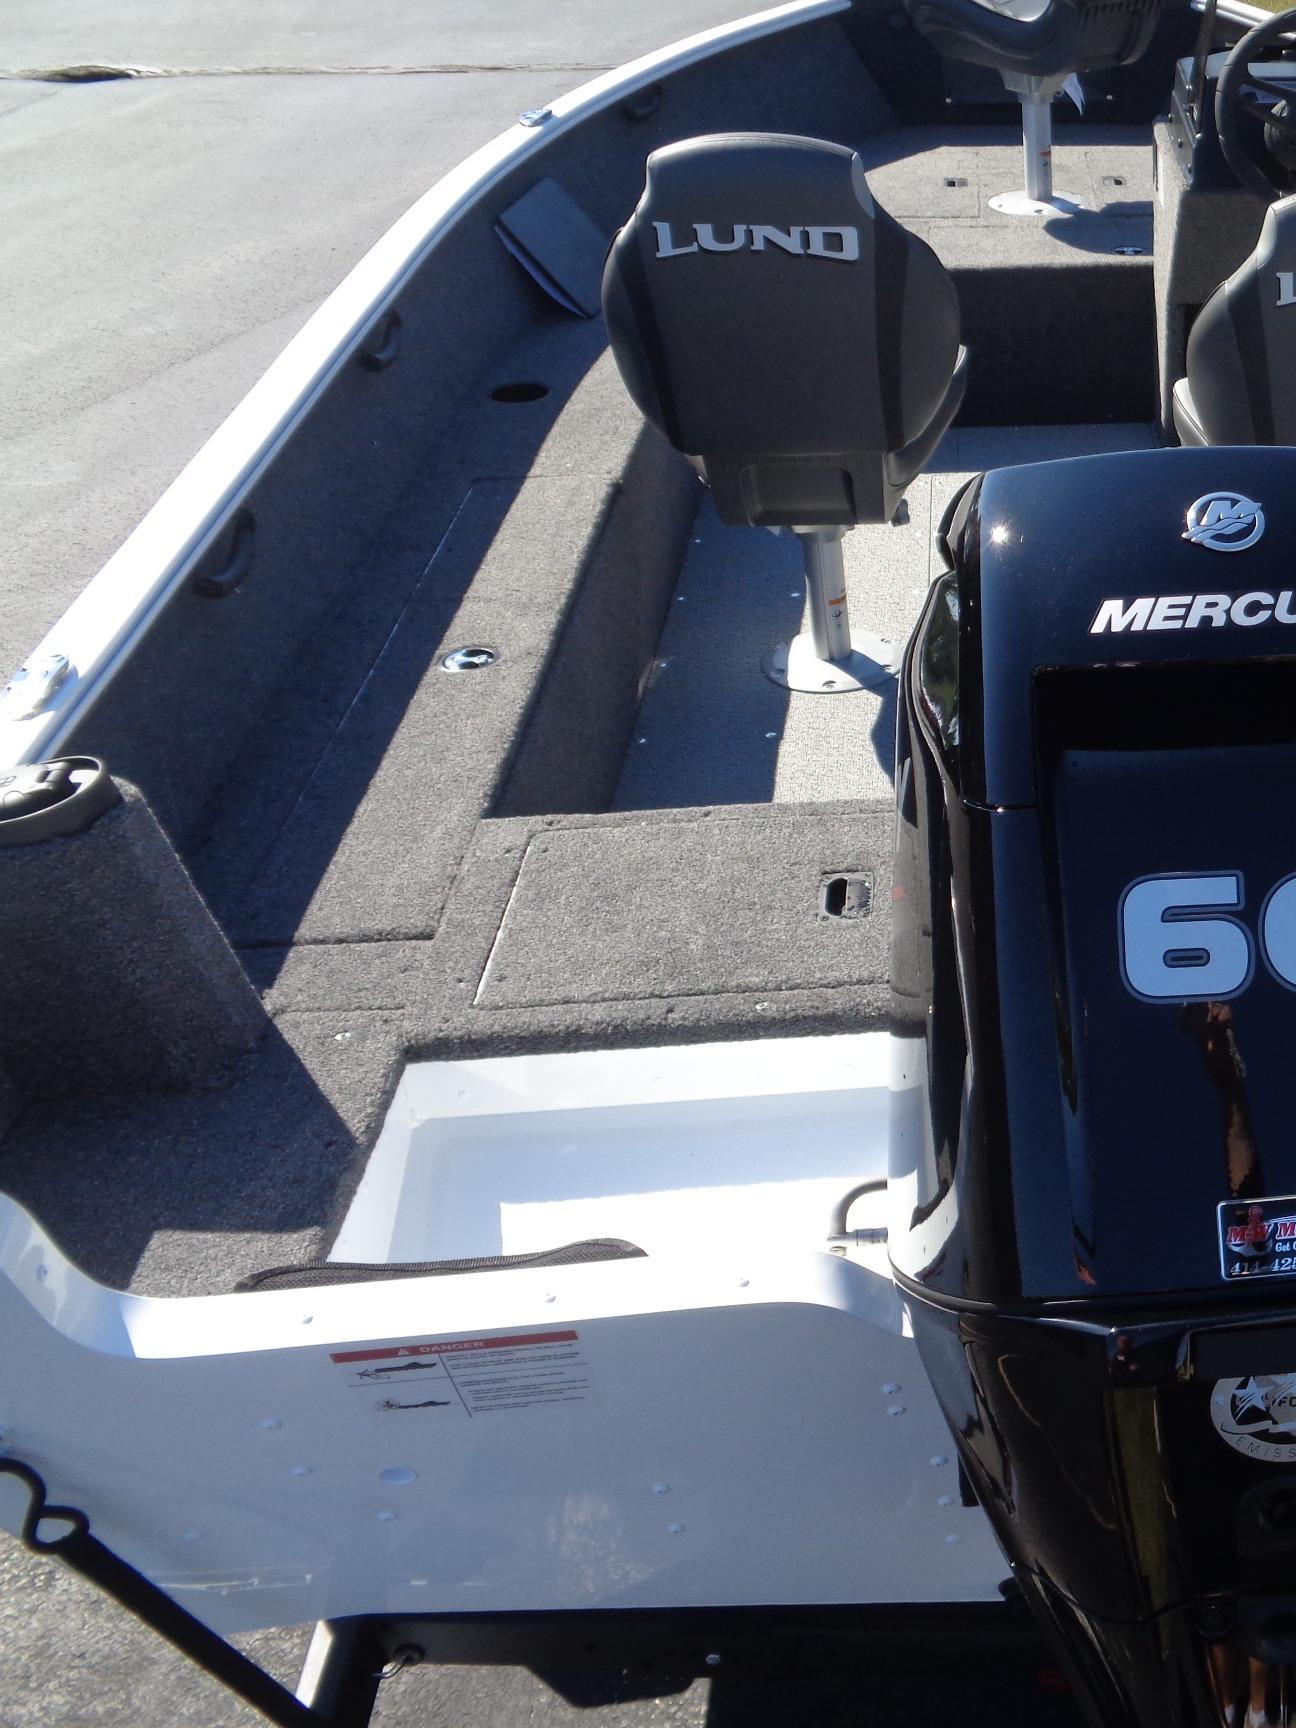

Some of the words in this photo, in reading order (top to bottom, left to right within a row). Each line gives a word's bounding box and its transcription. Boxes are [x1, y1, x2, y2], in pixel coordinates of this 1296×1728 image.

[652, 221, 859, 261] LUND
[1275, 1242, 1290, 1252] Get
[420, 1341, 484, 1353] DANGER
